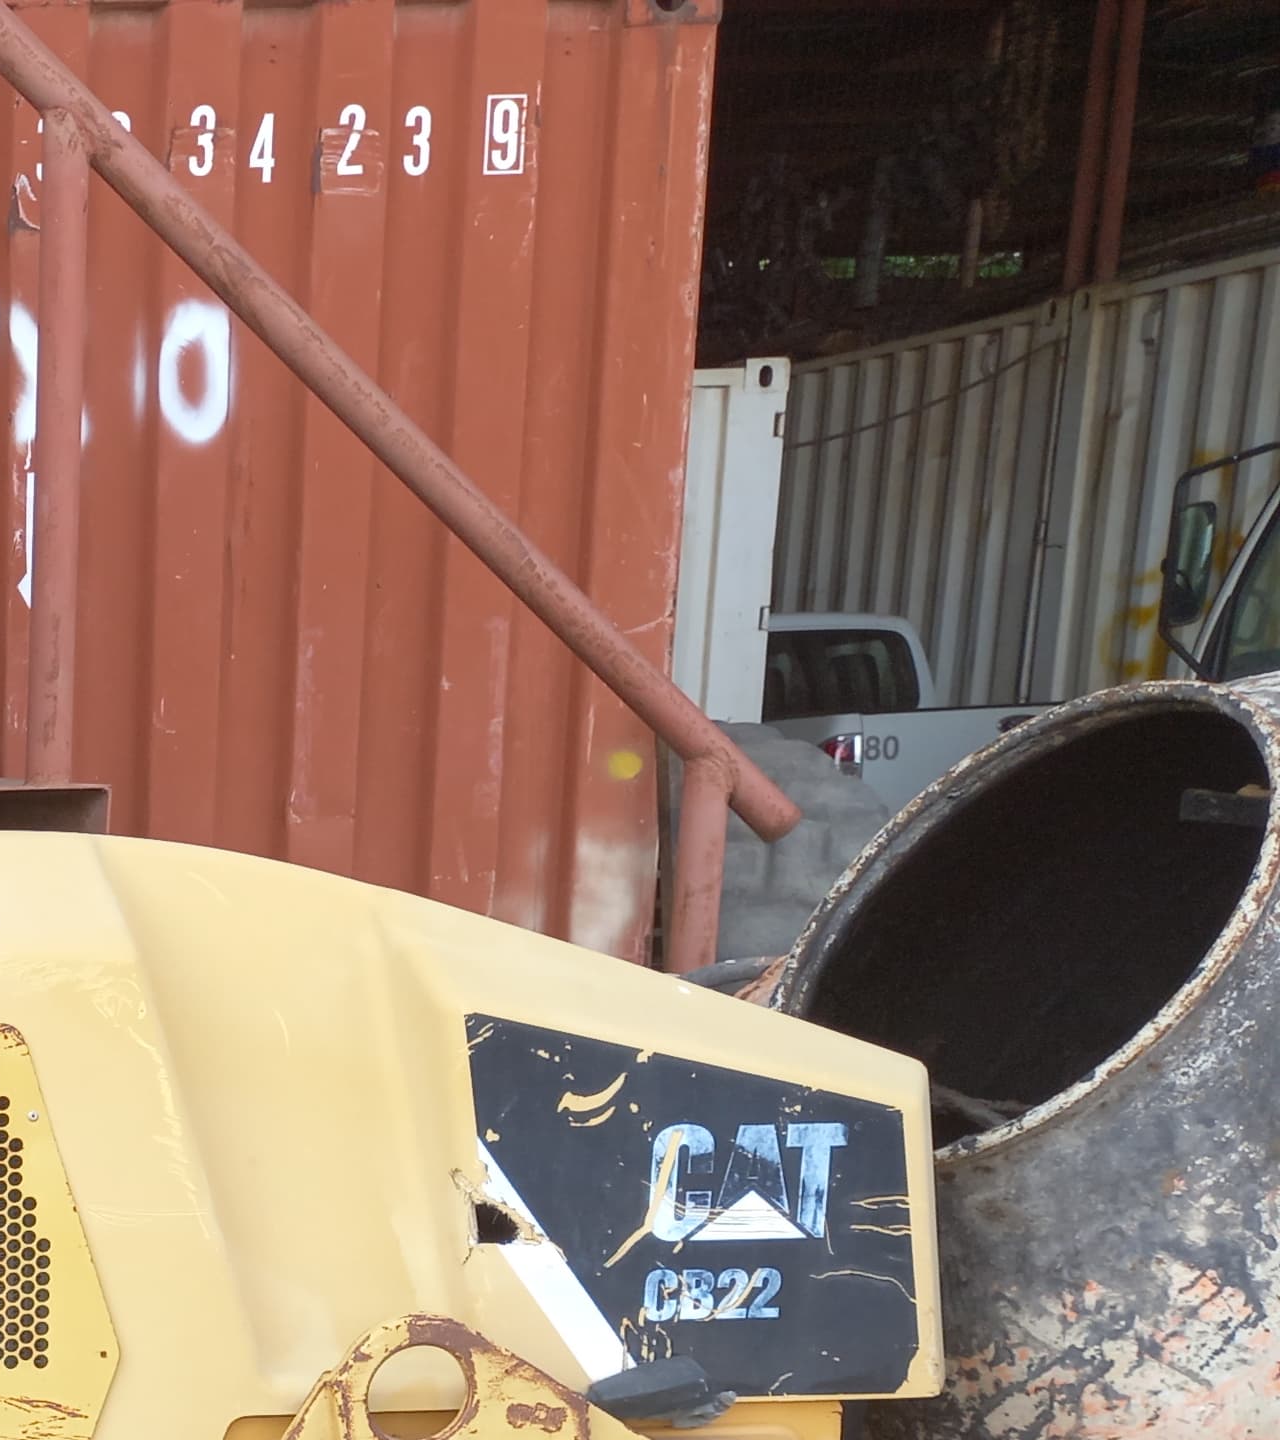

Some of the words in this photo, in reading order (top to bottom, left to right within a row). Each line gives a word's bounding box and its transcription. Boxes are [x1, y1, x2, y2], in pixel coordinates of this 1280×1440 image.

[34, 104, 432, 183] 3423
[649, 1122, 849, 1242] CAT
[642, 1267, 783, 1323] CB22
